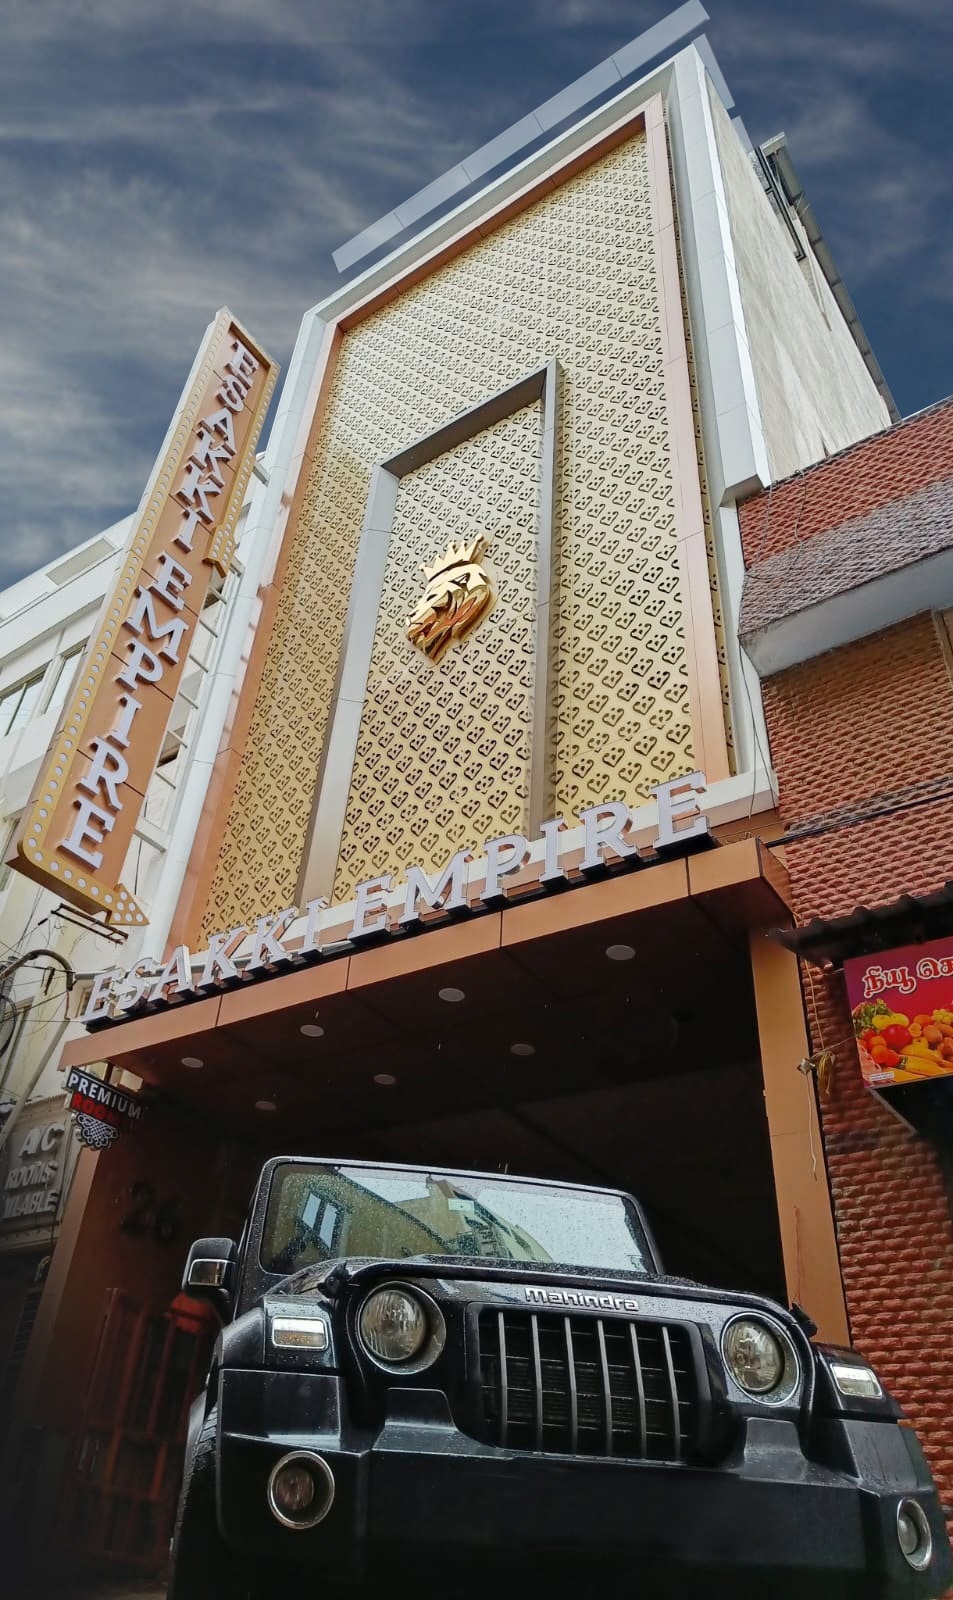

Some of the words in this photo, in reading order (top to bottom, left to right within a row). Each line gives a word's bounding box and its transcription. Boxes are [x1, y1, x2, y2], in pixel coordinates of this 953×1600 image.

[175, 338, 259, 553] ESAKKI
[59, 554, 190, 870] EMPIRE
[80, 896, 328, 1025] ESAKKI
[347, 770, 713, 941] EMPIRE
[862, 965, 916, 998] நியூ
[68, 1072, 142, 1121] PREMIUM
[4, 1160, 57, 1190] ROOMS
[524, 1286, 640, 1312] Mahindra
